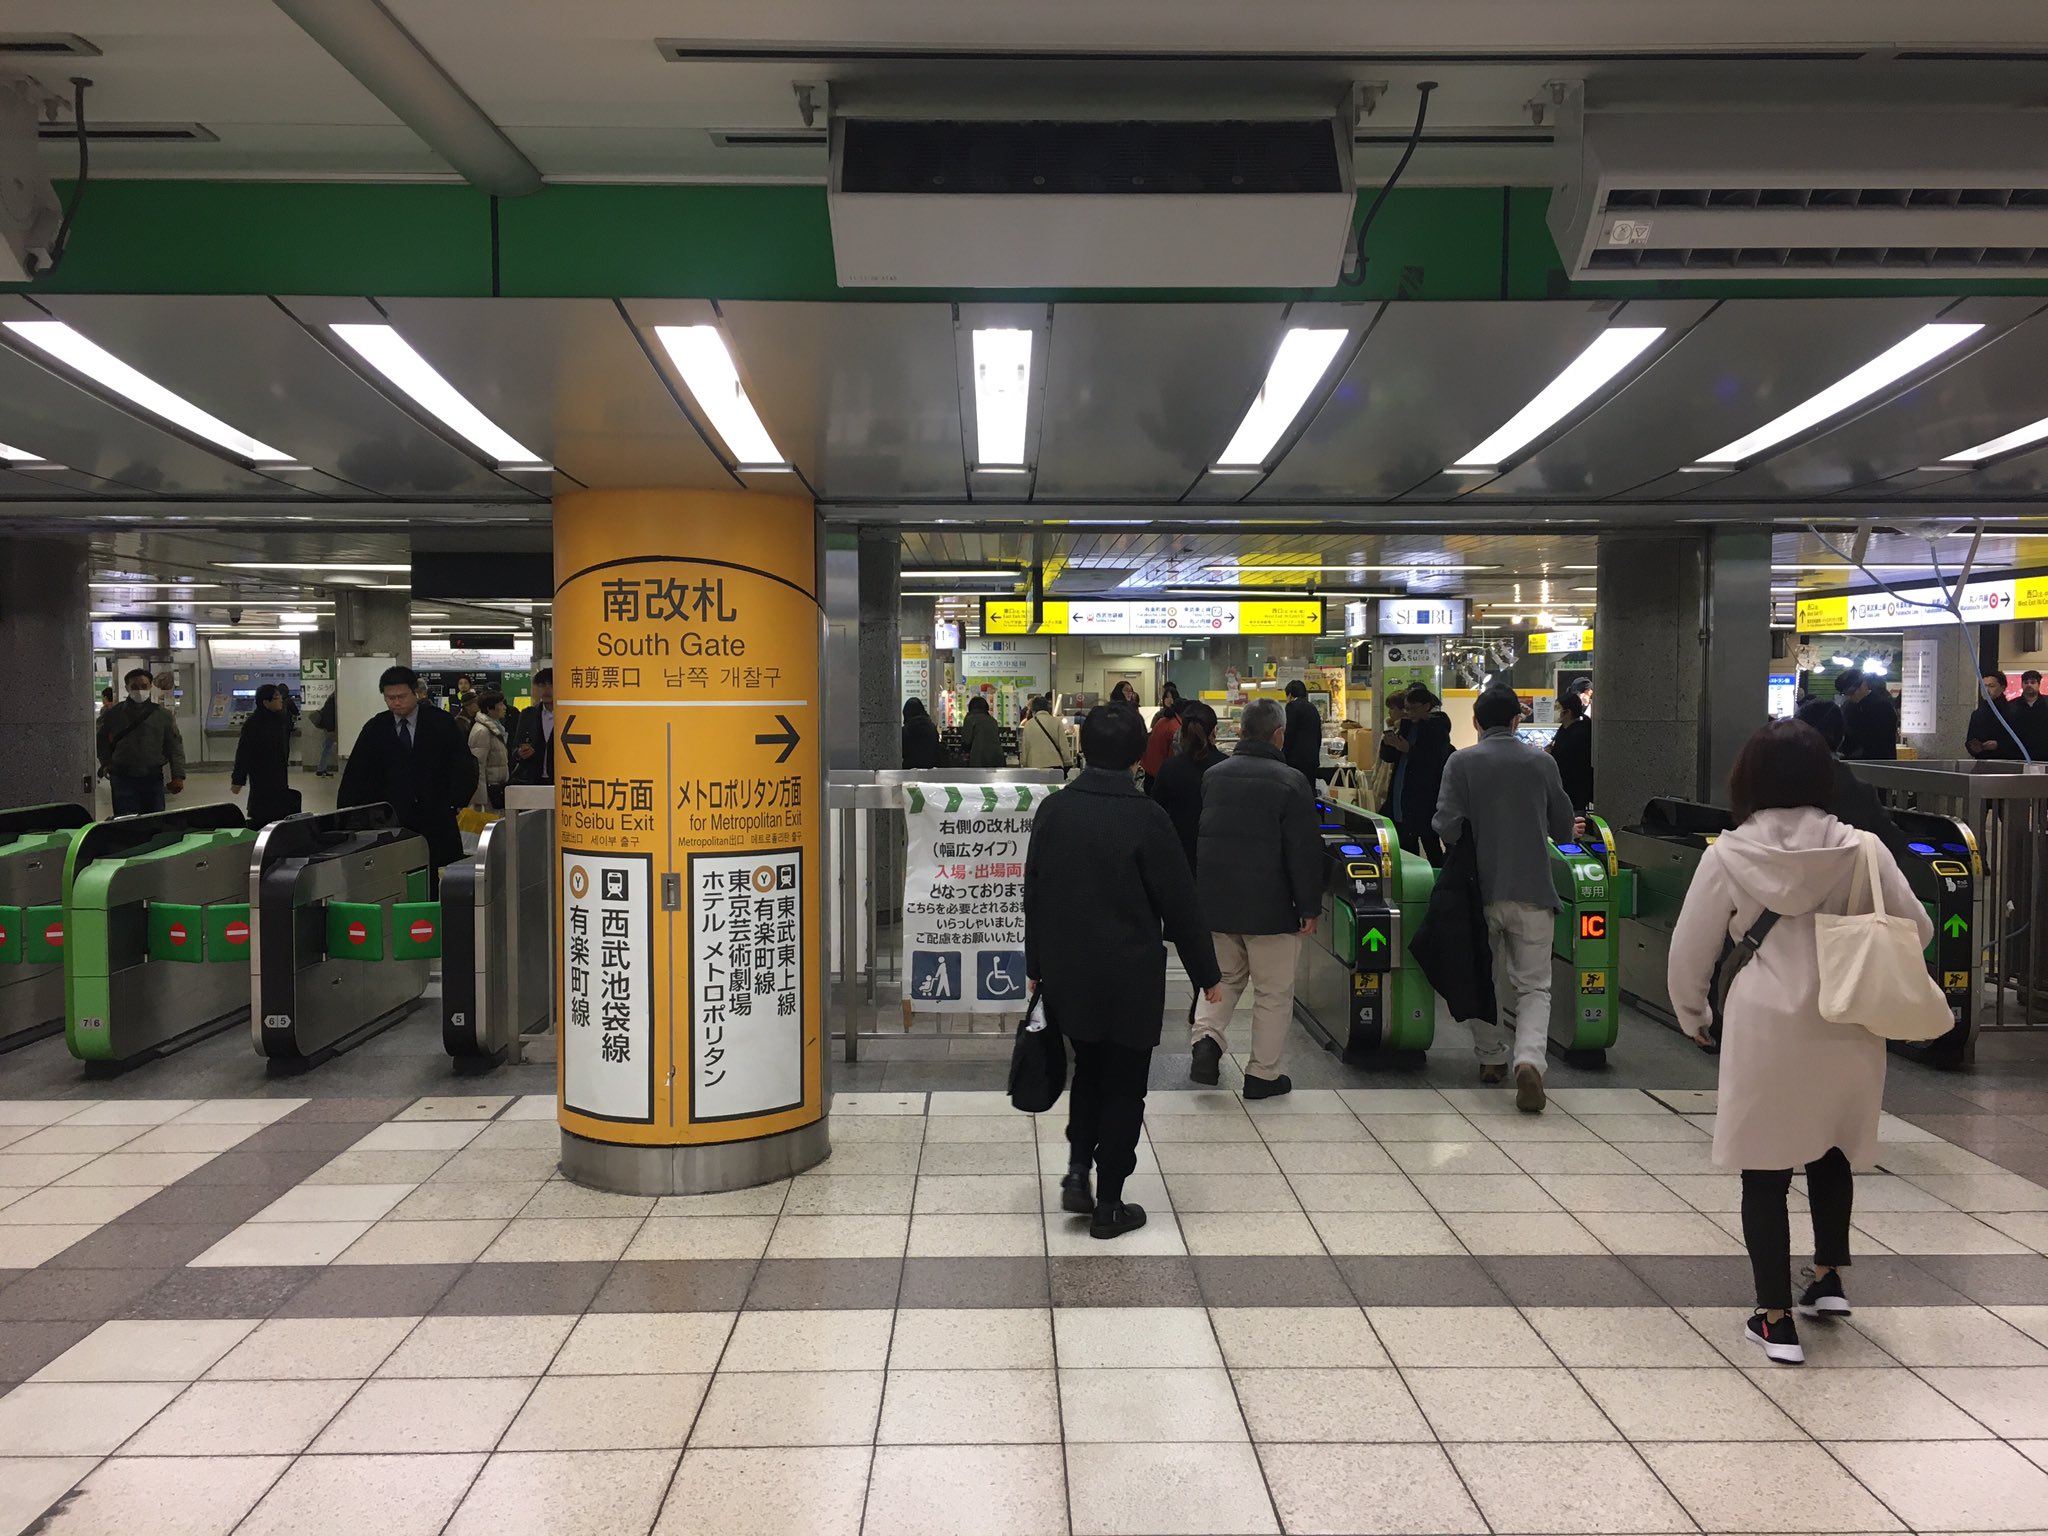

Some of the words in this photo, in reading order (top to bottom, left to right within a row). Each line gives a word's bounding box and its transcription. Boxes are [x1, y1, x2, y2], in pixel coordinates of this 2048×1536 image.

[602, 577, 737, 622] 南改札
[597, 632, 670, 656] South
[680, 632, 746, 657] Gate
[303, 660, 327, 674] JR
[571, 666, 641, 689] 南剪票口
[663, 666, 709, 689] 남쪽
[720, 666, 782, 689] 개찰구
[561, 775, 654, 811] 西武口方面
[677, 776, 801, 810] メトロポリタン方面
[561, 810, 572, 827] for
[575, 811, 614, 830] Seibu
[621, 813, 654, 831] Exit
[690, 813, 707, 831] for
[711, 811, 782, 833] Metropolitan
[785, 810, 802, 826] Exit
[590, 834, 617, 846] 세이부
[934, 863, 1026, 880] 入場・出場両
[1575, 863, 1604, 881] IC
[702, 871, 725, 933] ホテル
[1581, 886, 1604, 898] 専用
[936, 916, 1024, 930] いらっしゃいました
[1582, 915, 1604, 937] IC
[728, 869, 752, 1017] 東京芸術劇場
[754, 897, 776, 996] 有楽町線
[570, 904, 590, 1028] 有楽町線
[776, 895, 796, 1017] 東武東上線
[601, 908, 631, 1064] 西武池袋線
[703, 941, 726, 1088] メトロポリタン
